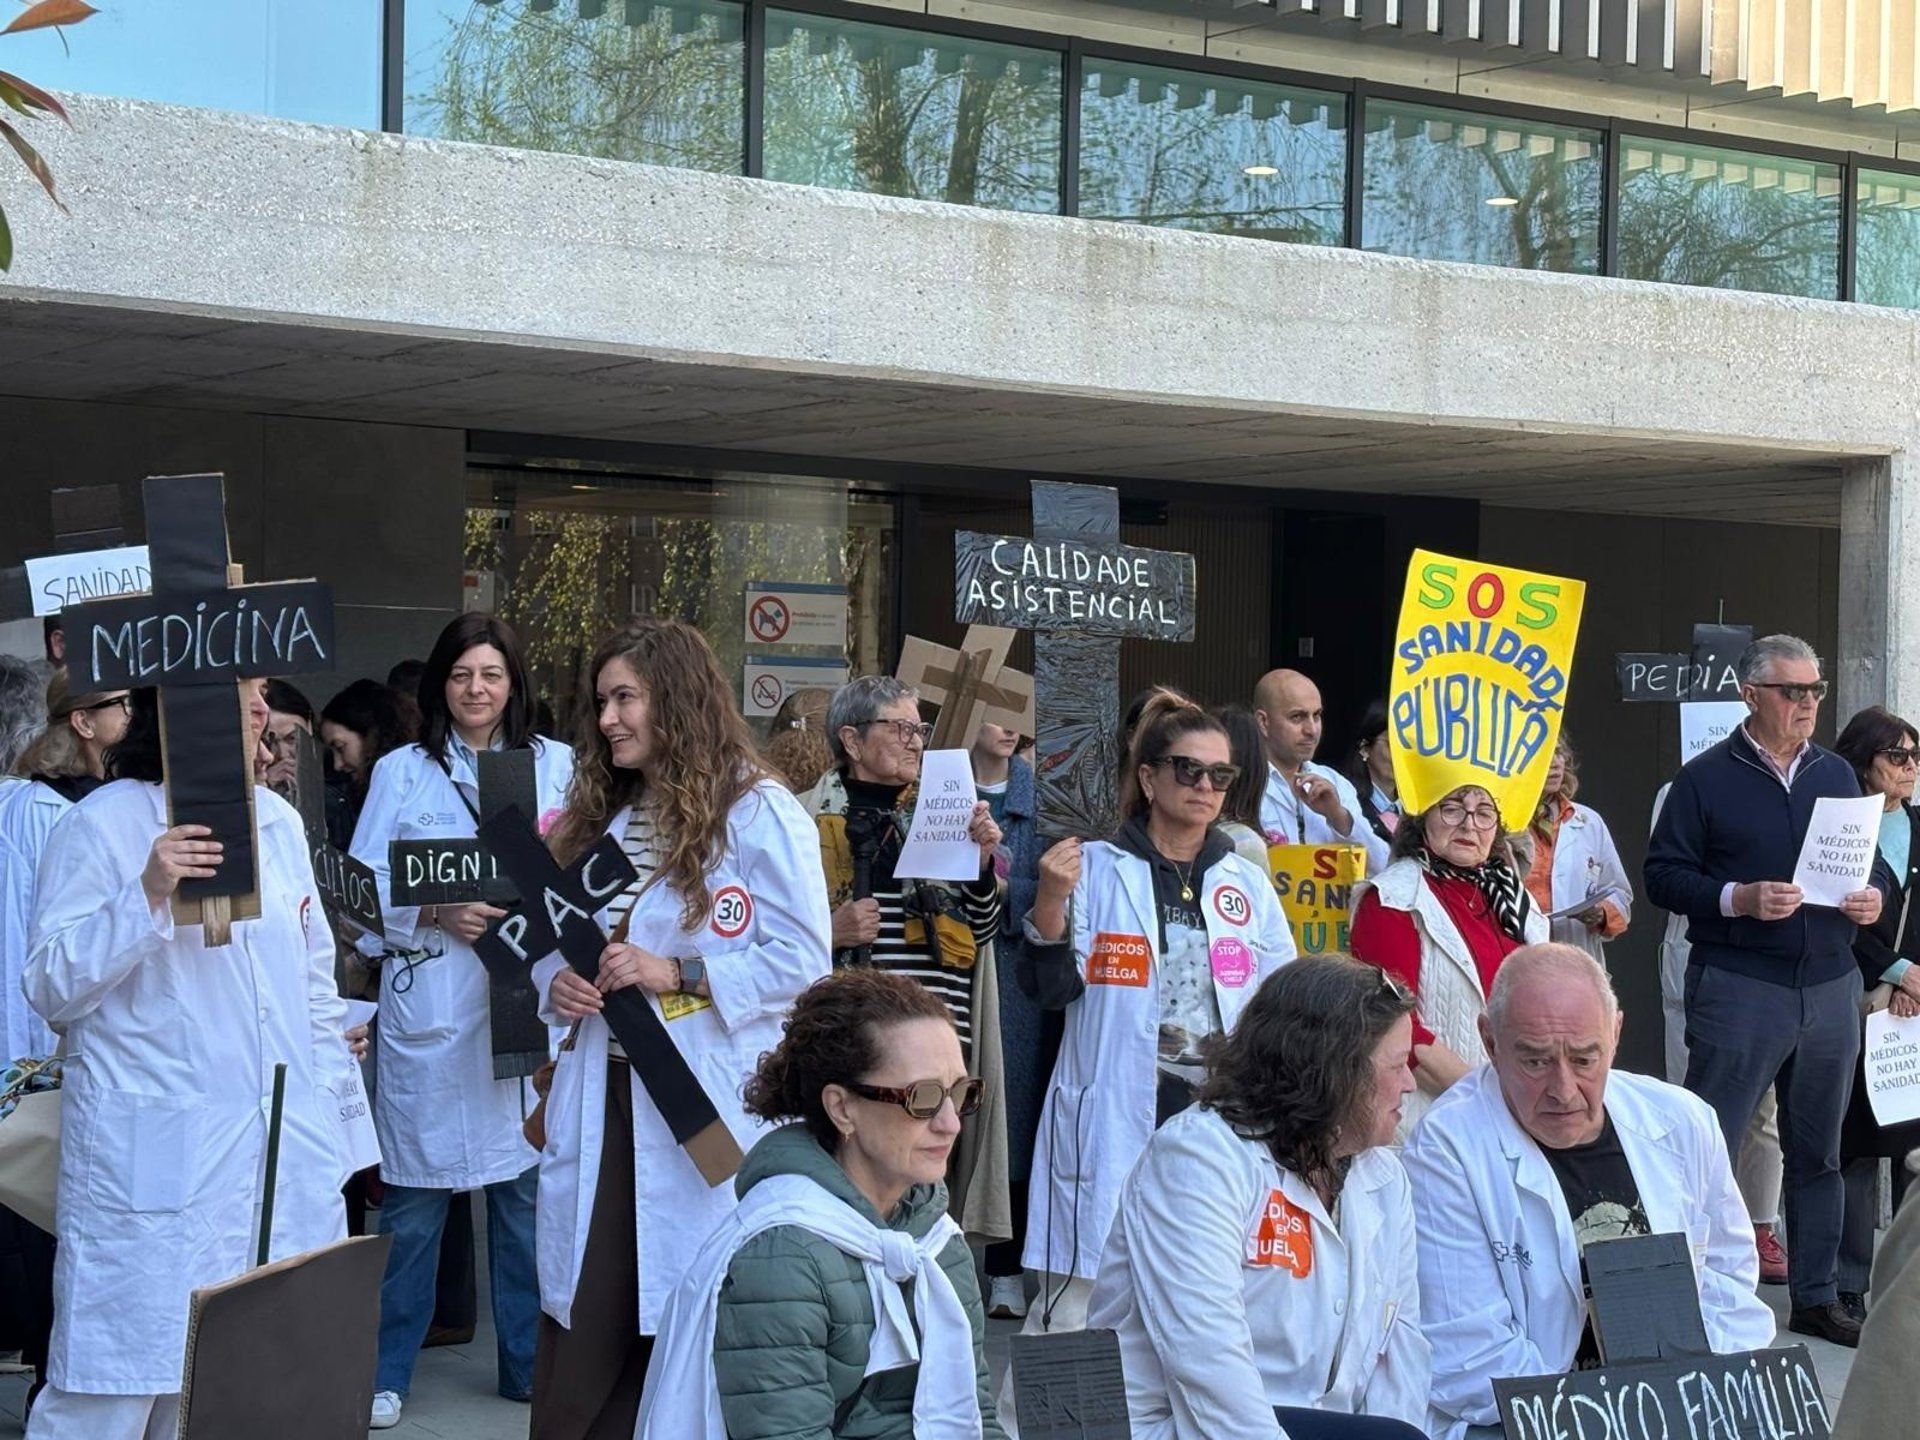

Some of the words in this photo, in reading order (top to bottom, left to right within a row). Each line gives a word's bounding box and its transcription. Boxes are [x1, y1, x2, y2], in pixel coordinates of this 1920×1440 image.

[991, 539, 1149, 588] CALIDADE
[968, 579, 1176, 625] ASISTENCIAL
[1418, 563, 1560, 630] SOS
[91, 599, 326, 683] MEDICINA
[1399, 621, 1565, 699] SANIDAD
[1708, 726, 1728, 736] SIN
[943, 779, 960, 793] SIN
[923, 794, 974, 811] MÉDICOS
[924, 813, 944, 827] NO
[944, 812, 969, 828] HAY
[1841, 824, 1861, 834] SIN
[913, 827, 968, 843] SANIDAD
[1816, 833, 1870, 849] MÉDICOS
[1819, 850, 1838, 861] NO
[1841, 851, 1866, 862] HAY
[1806, 861, 1865, 878] SANIDAD
[497, 852, 624, 962] PAC
[717, 898, 744, 922] 30
[1221, 894, 1244, 914] 30
[1217, 946, 1241, 956] STOP
[1883, 1030, 1901, 1043] SIN
[1869, 1042, 1919, 1063] MÉDICOS
[1876, 1064, 1893, 1076] NO
[1894, 1057, 1917, 1072] HAY
[1510, 1374, 1668, 1440] MÉDICO
[1677, 1357, 1832, 1440] FAMILIA
